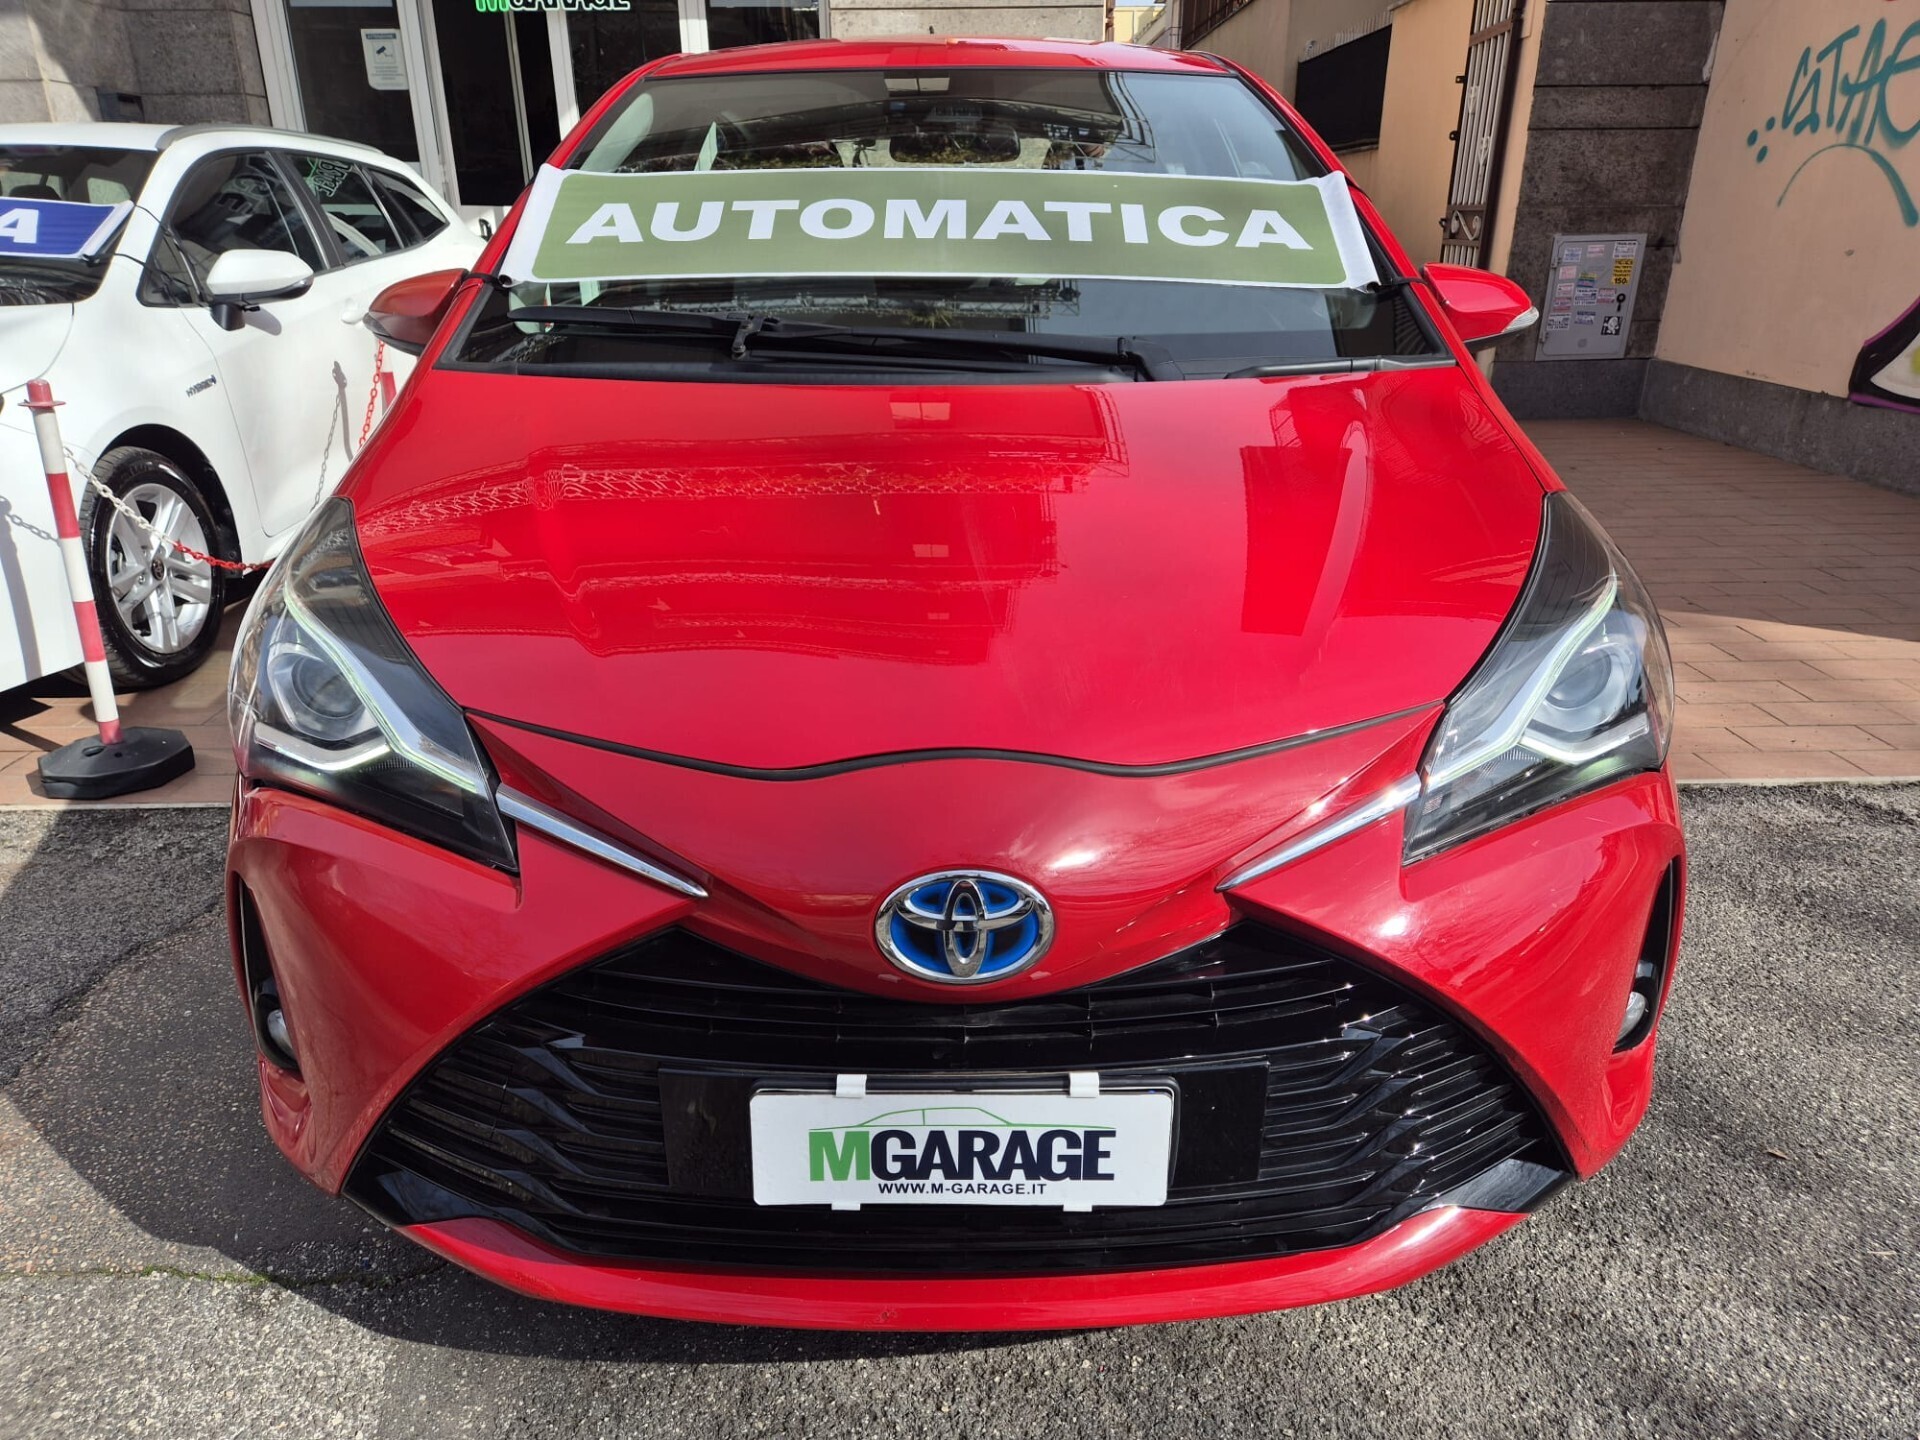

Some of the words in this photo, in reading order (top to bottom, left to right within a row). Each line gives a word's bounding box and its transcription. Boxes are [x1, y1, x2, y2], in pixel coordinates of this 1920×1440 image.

[567, 198, 1314, 251] AUTOMATICA
[809, 1129, 1117, 1182] MGARAGE
[878, 1181, 1048, 1196] WWW.M-GARAGE.IT
